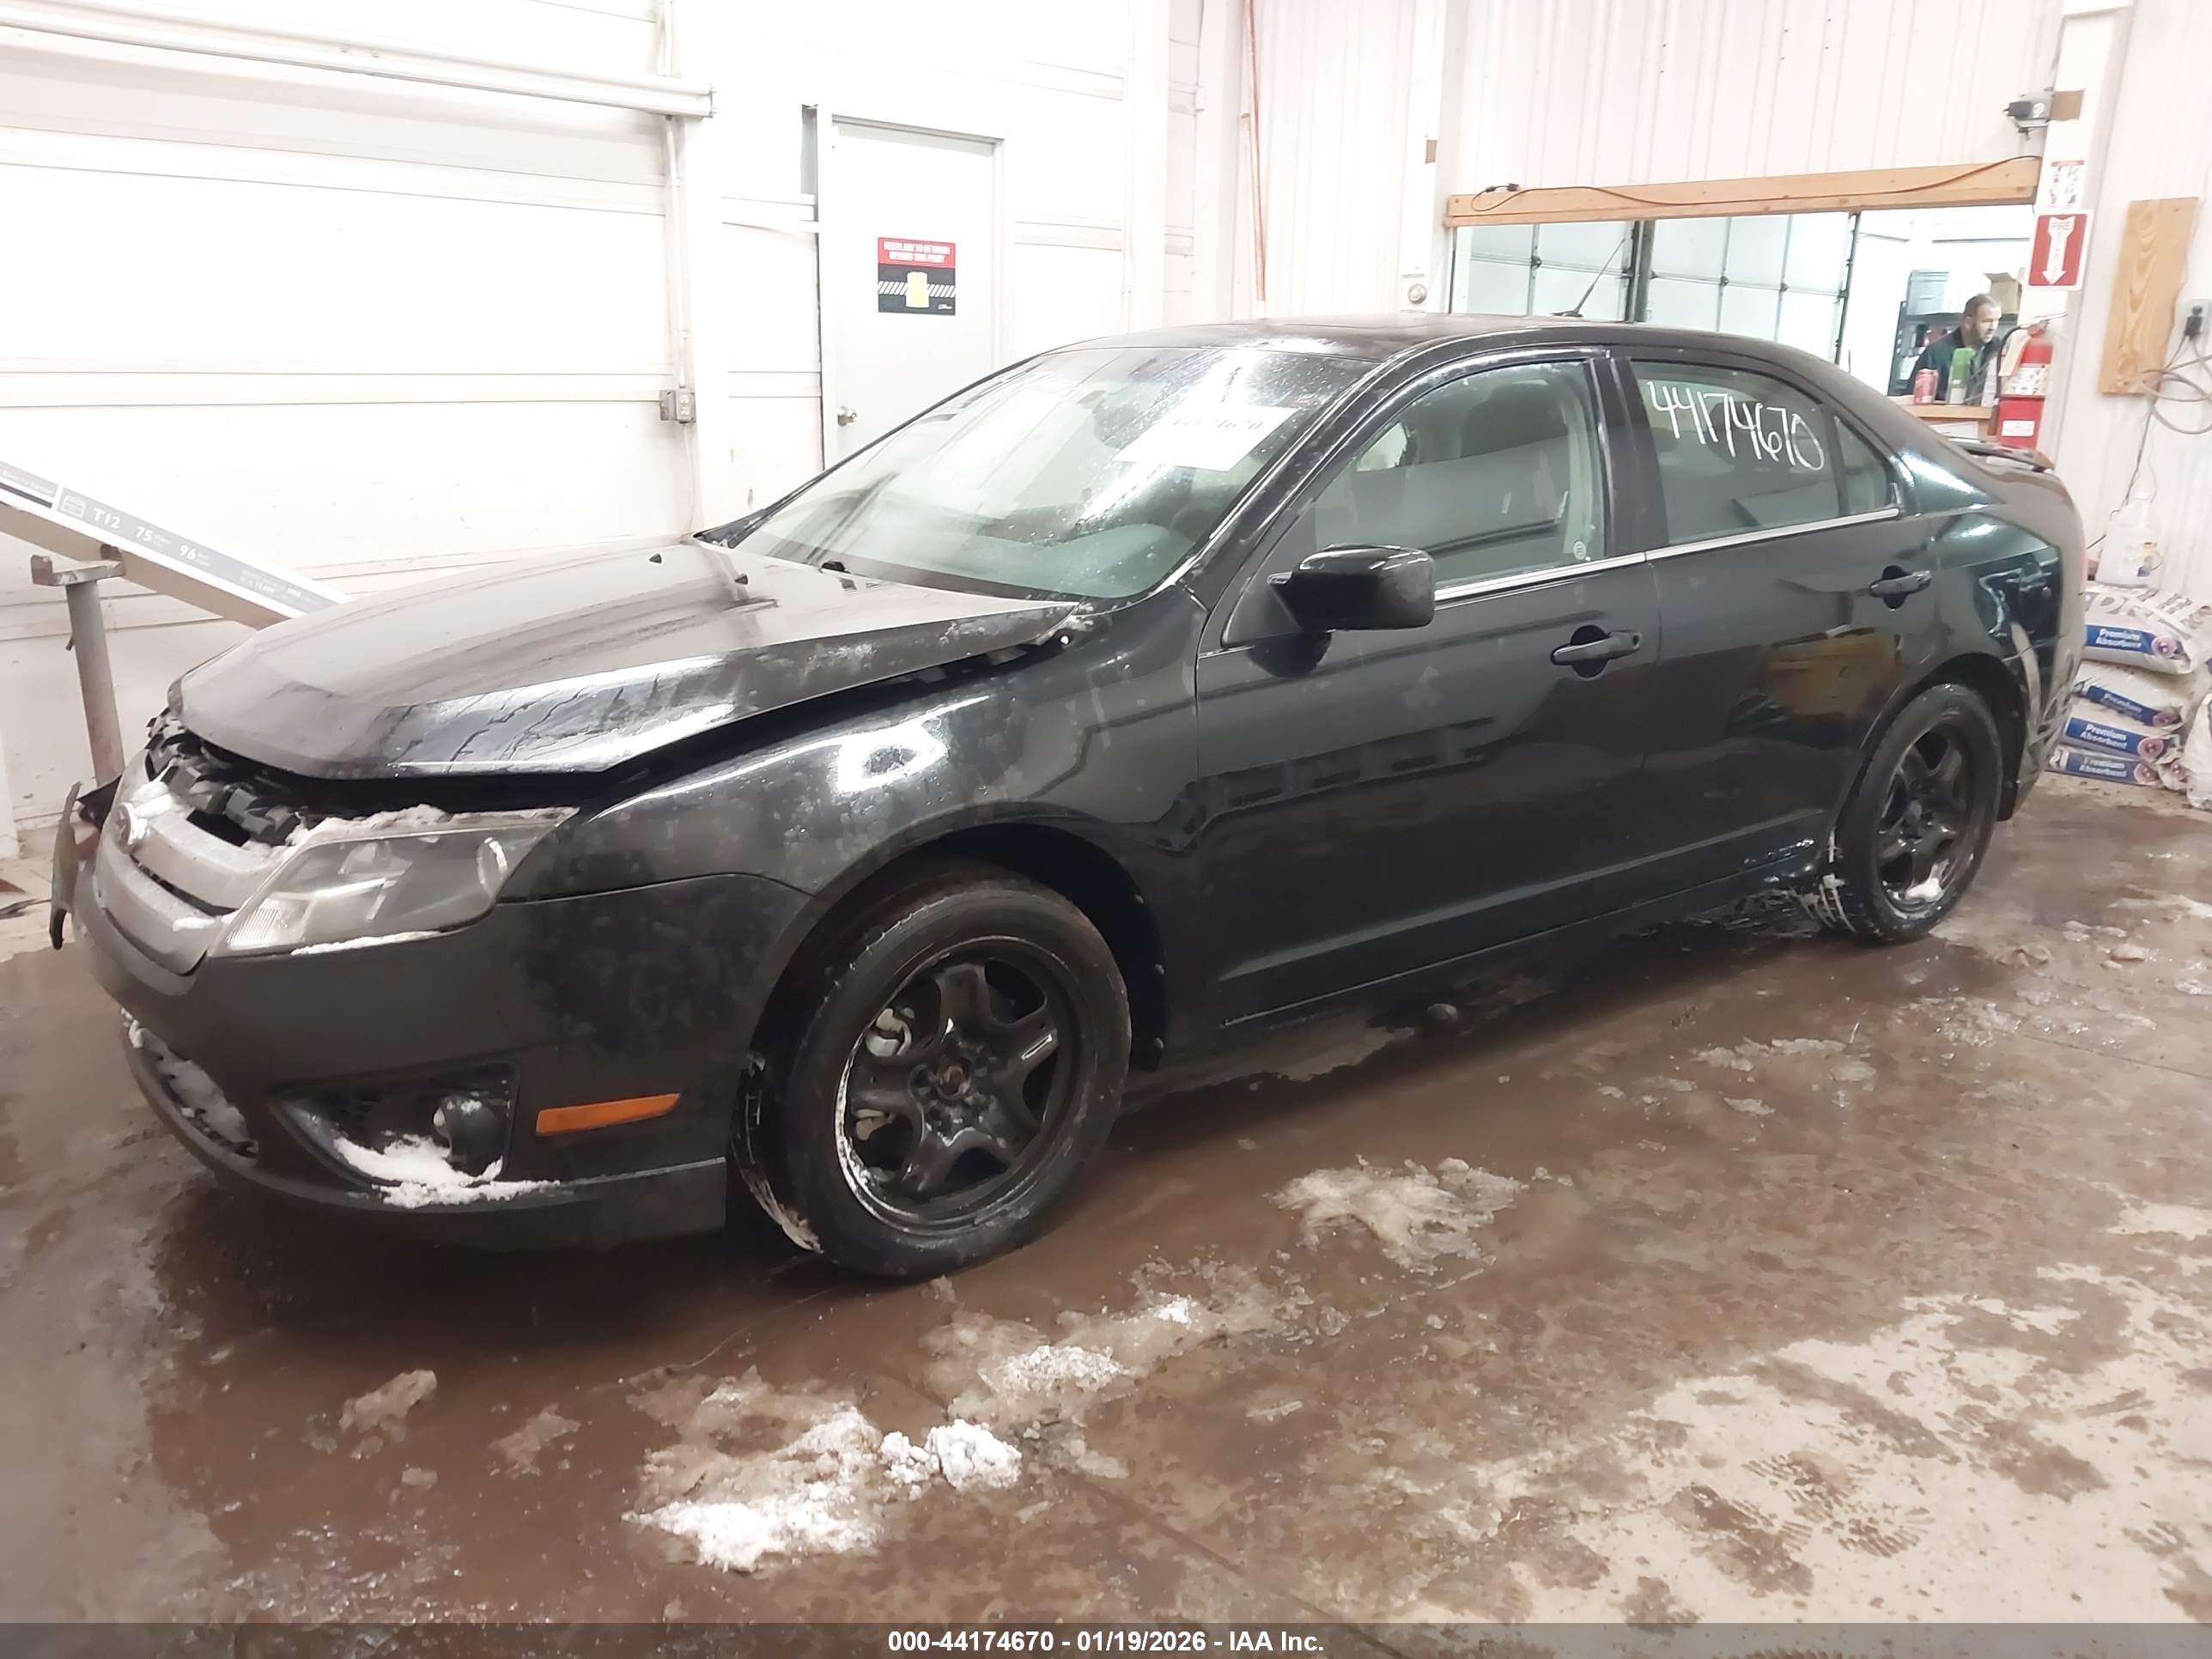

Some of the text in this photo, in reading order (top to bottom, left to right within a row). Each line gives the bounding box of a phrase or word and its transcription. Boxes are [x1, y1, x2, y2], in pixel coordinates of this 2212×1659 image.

[1646, 380, 1826, 471] 44174670
[93, 507, 122, 530] T12
[135, 526, 154, 543] 75
[179, 544, 197, 561] 96
[2095, 636, 2142, 648] Absorbent
[2099, 628, 2141, 641] Premium
[2080, 731, 2128, 750] Absorbent
[2086, 724, 2128, 741] Premium
[2079, 764, 2127, 778] Absorbent
